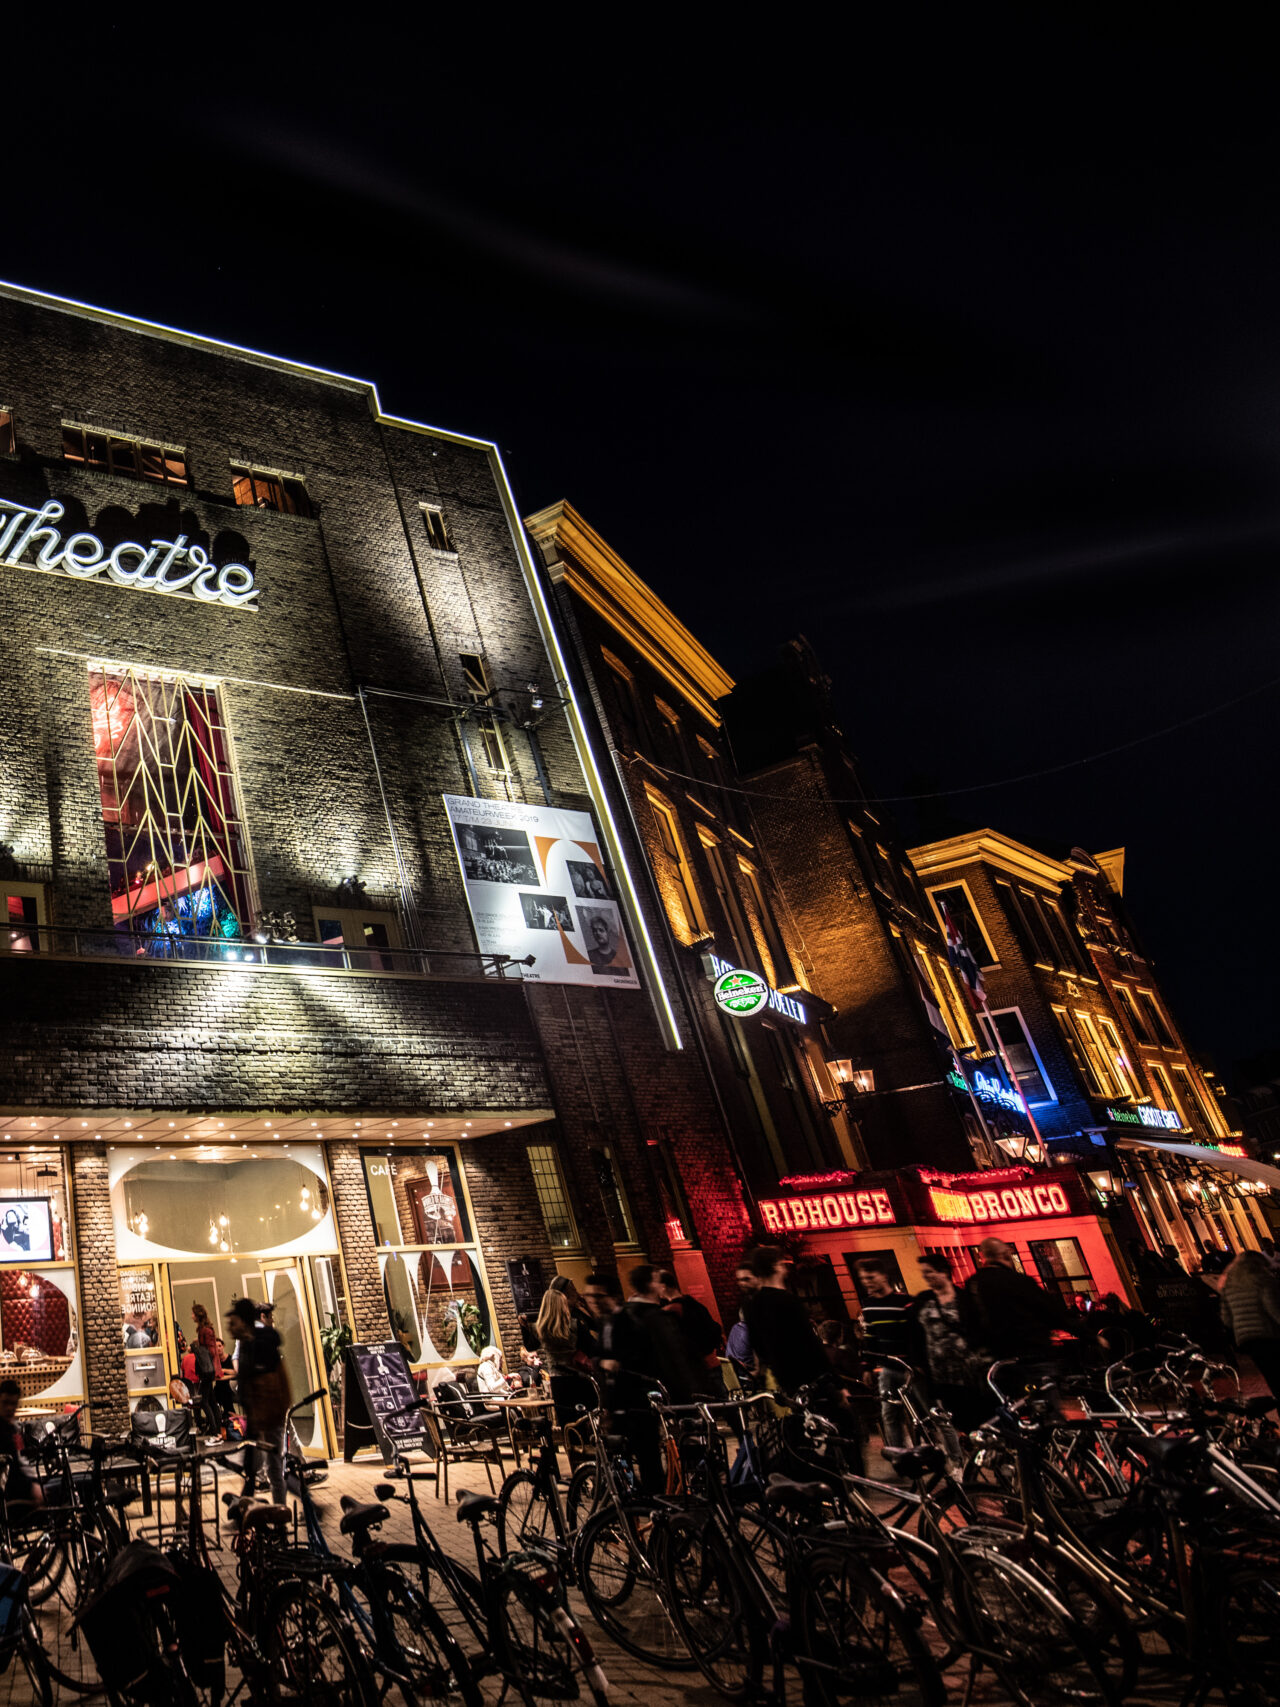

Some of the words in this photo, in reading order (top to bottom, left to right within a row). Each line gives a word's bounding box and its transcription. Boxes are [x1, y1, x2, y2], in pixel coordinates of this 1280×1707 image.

[447, 797, 480, 808] GRAND
[717, 983, 766, 1002] Heineken
[1111, 1108, 1139, 1124] Heineken
[370, 1162, 398, 1176] CAFÉ
[762, 1190, 894, 1229] RIBHOUSE
[970, 1183, 1068, 1219] BRONCO
